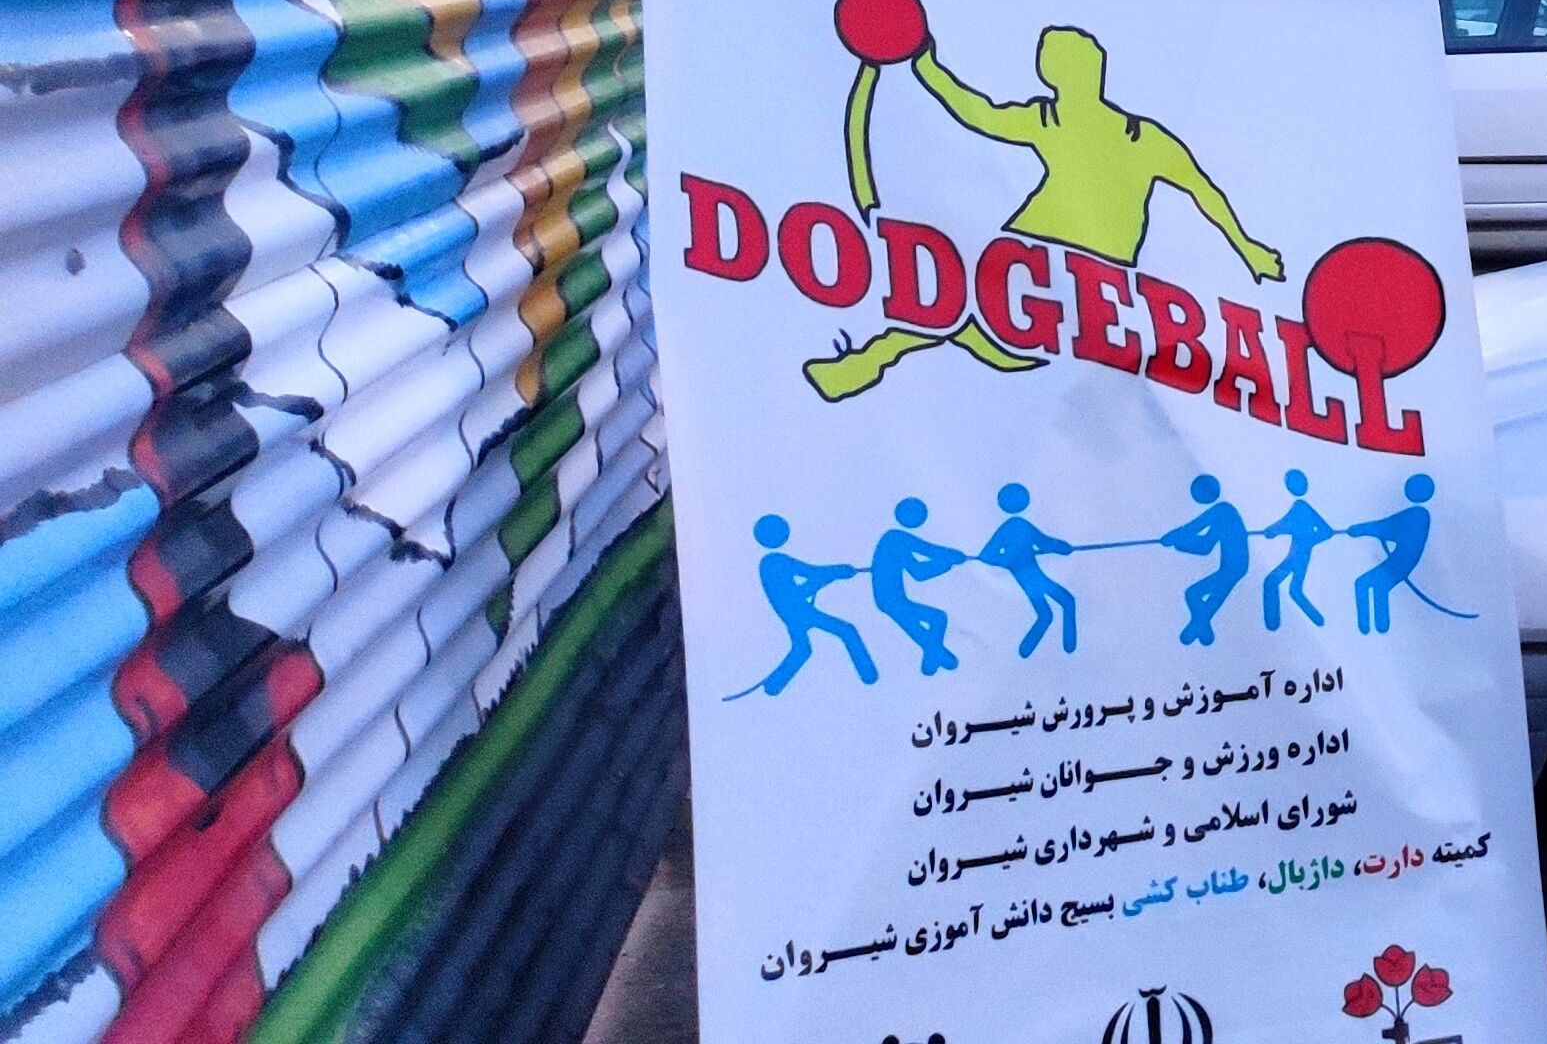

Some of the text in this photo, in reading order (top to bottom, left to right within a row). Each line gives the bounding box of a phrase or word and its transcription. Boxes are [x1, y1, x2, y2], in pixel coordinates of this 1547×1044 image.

[679, 172, 1426, 457] DODGEBALL
[911, 667, 1344, 748] اداره آموزش و پرورش شیروان
[913, 728, 1349, 816] اداره ورزش و جوانان شیروان
[907, 790, 1358, 886] شورای اسلامی و شهرداری شیروان
[1432, 832, 1491, 869] کمیته
[1122, 875, 1178, 916] کشی
[1186, 866, 1249, 900] طناب
[905, 903, 984, 956] آموزی
[991, 897, 1052, 940] دانش
[1060, 893, 1114, 927] بسیج
[760, 922, 897, 982] شیروان
